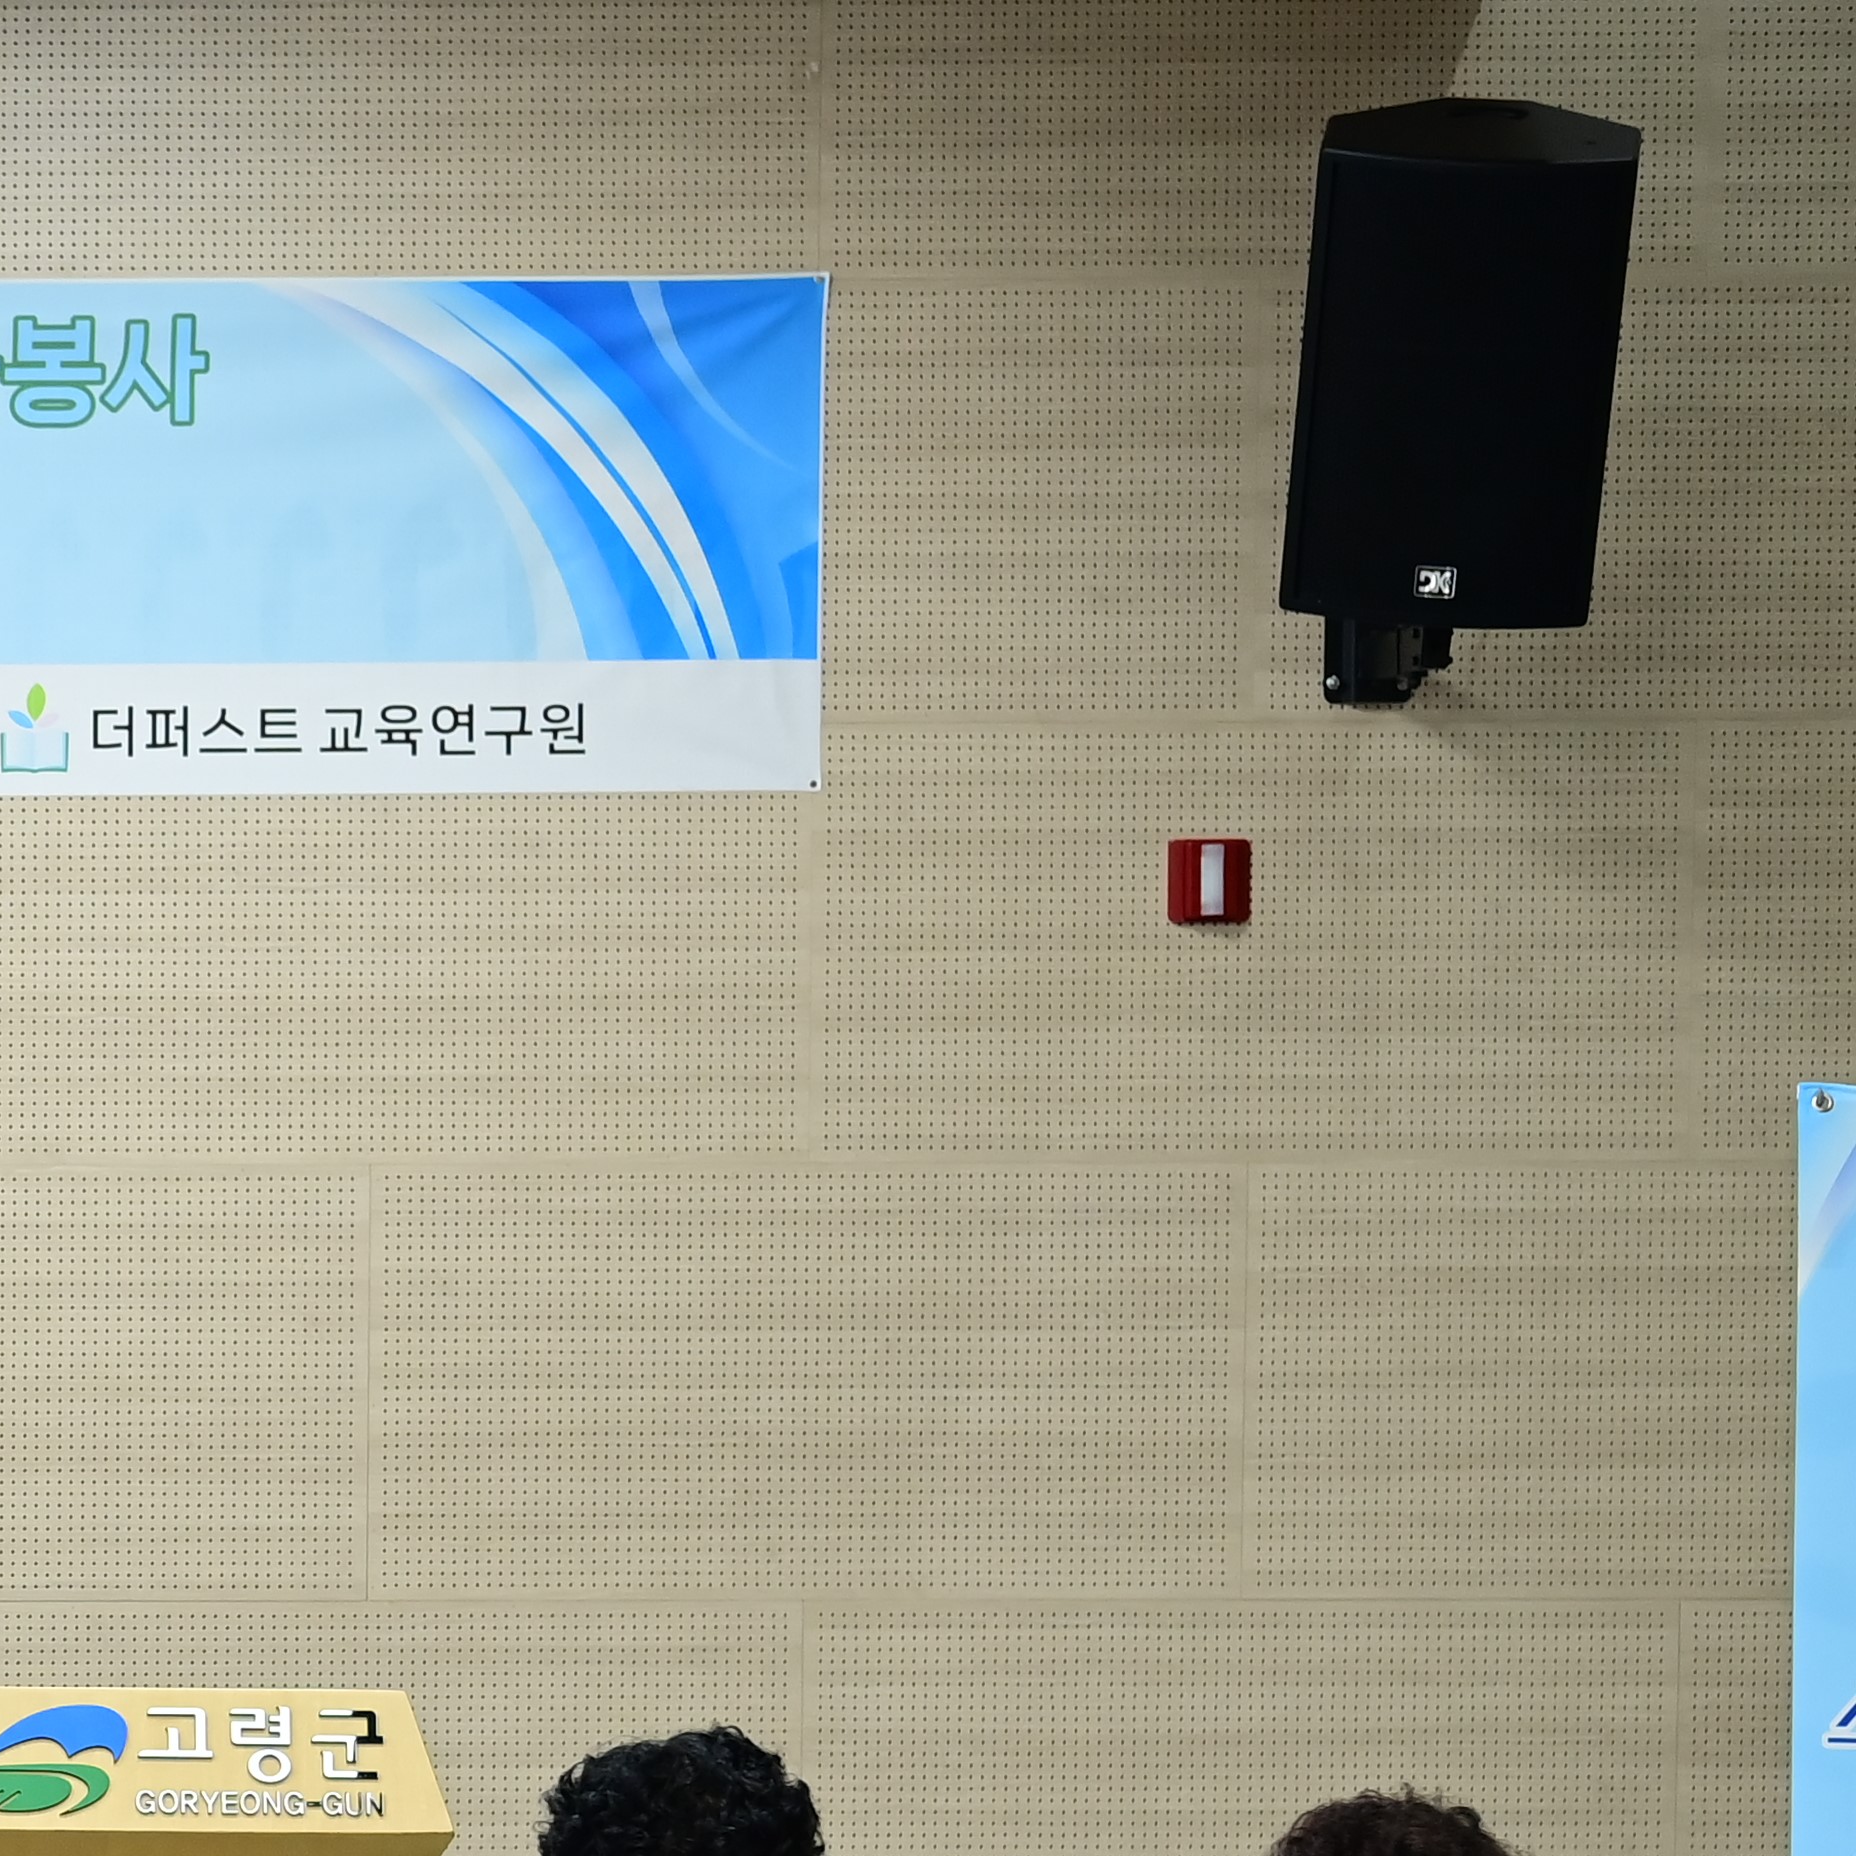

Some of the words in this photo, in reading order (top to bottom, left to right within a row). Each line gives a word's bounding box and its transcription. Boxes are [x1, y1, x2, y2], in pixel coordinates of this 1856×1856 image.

[92, 705, 304, 758] 더퍼스트
[319, 702, 586, 757] 교육연구원
[137, 1705, 384, 1784] 고령군
[134, 1788, 385, 1817] GORYEONG-GUN
